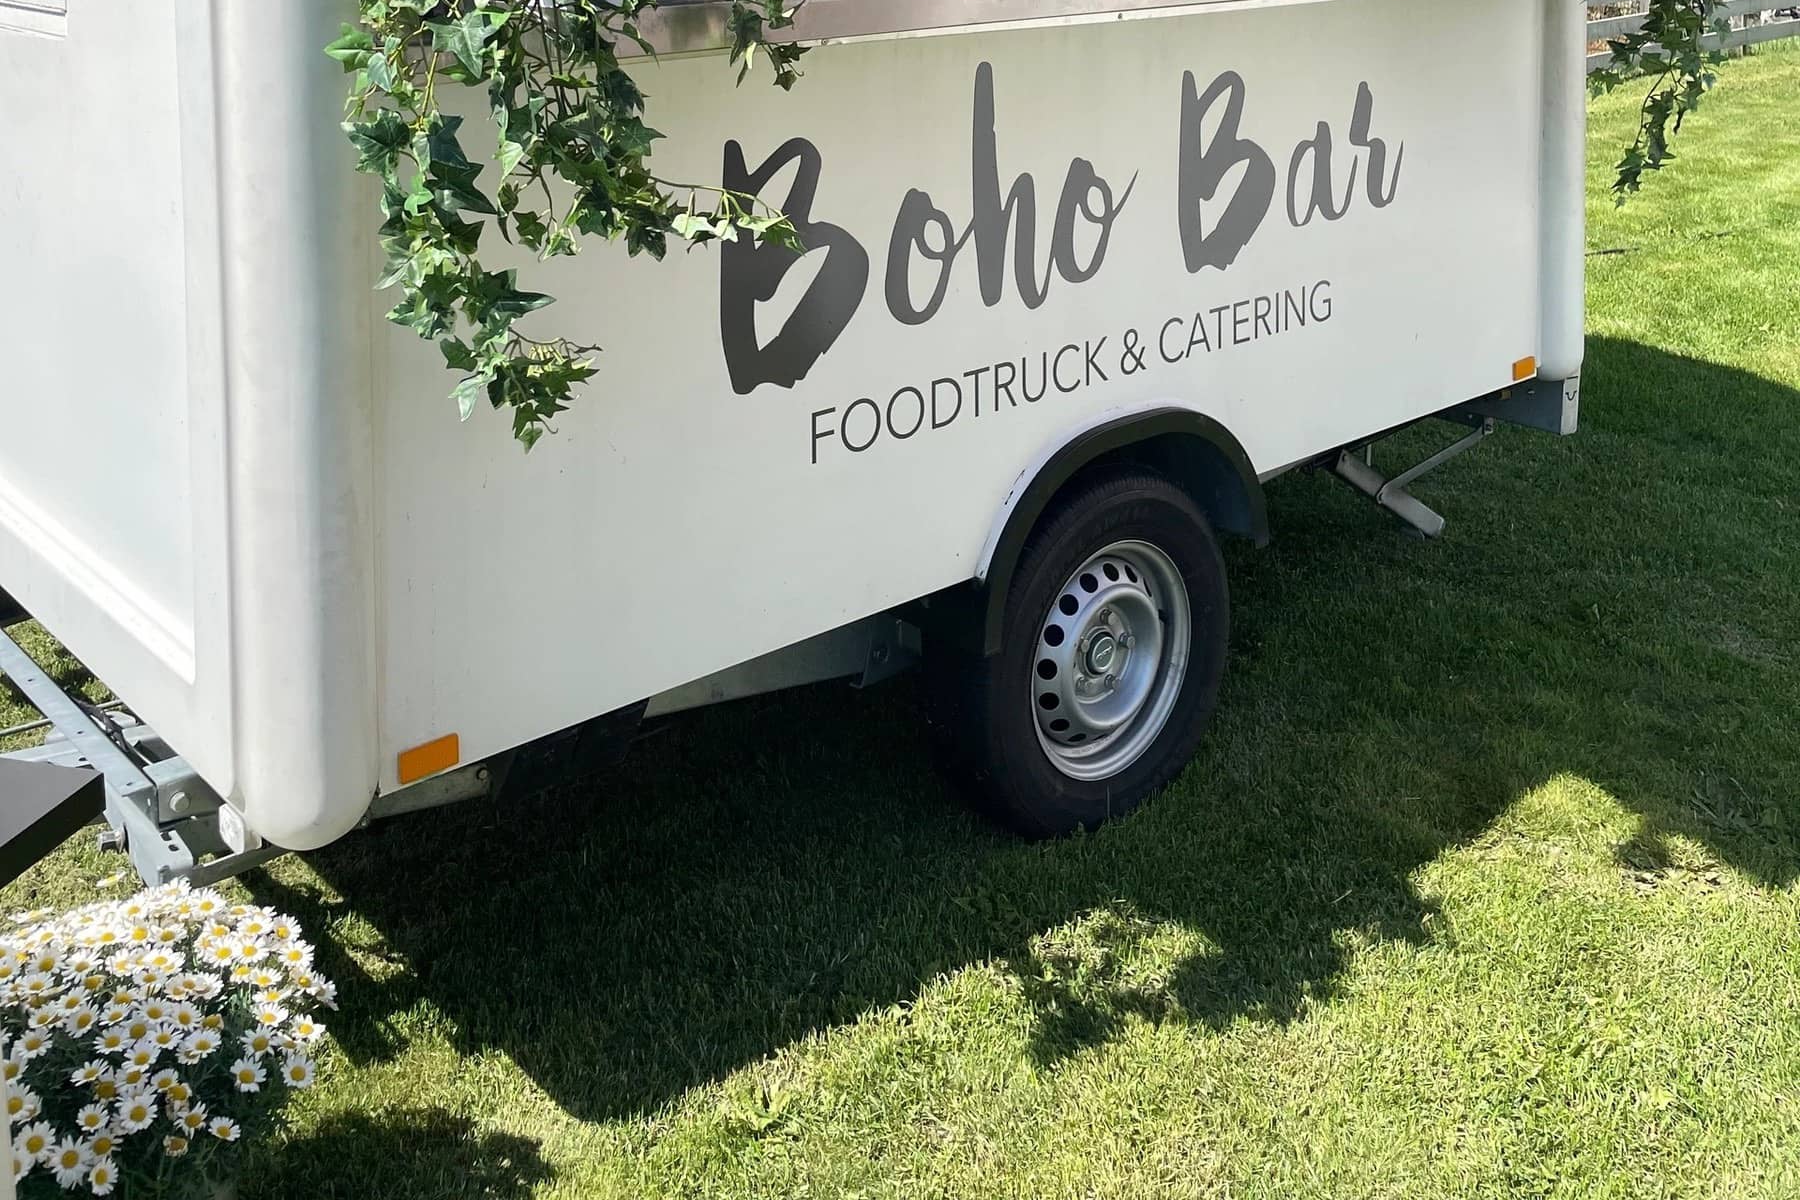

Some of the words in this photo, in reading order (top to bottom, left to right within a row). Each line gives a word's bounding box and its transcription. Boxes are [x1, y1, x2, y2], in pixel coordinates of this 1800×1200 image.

[721, 61, 1139, 395] Boho
[1178, 70, 1404, 274] Bar
[811, 335, 1109, 465] FOODTRUCK
[1121, 328, 1147, 376] &
[1159, 280, 1332, 364] CATERING
